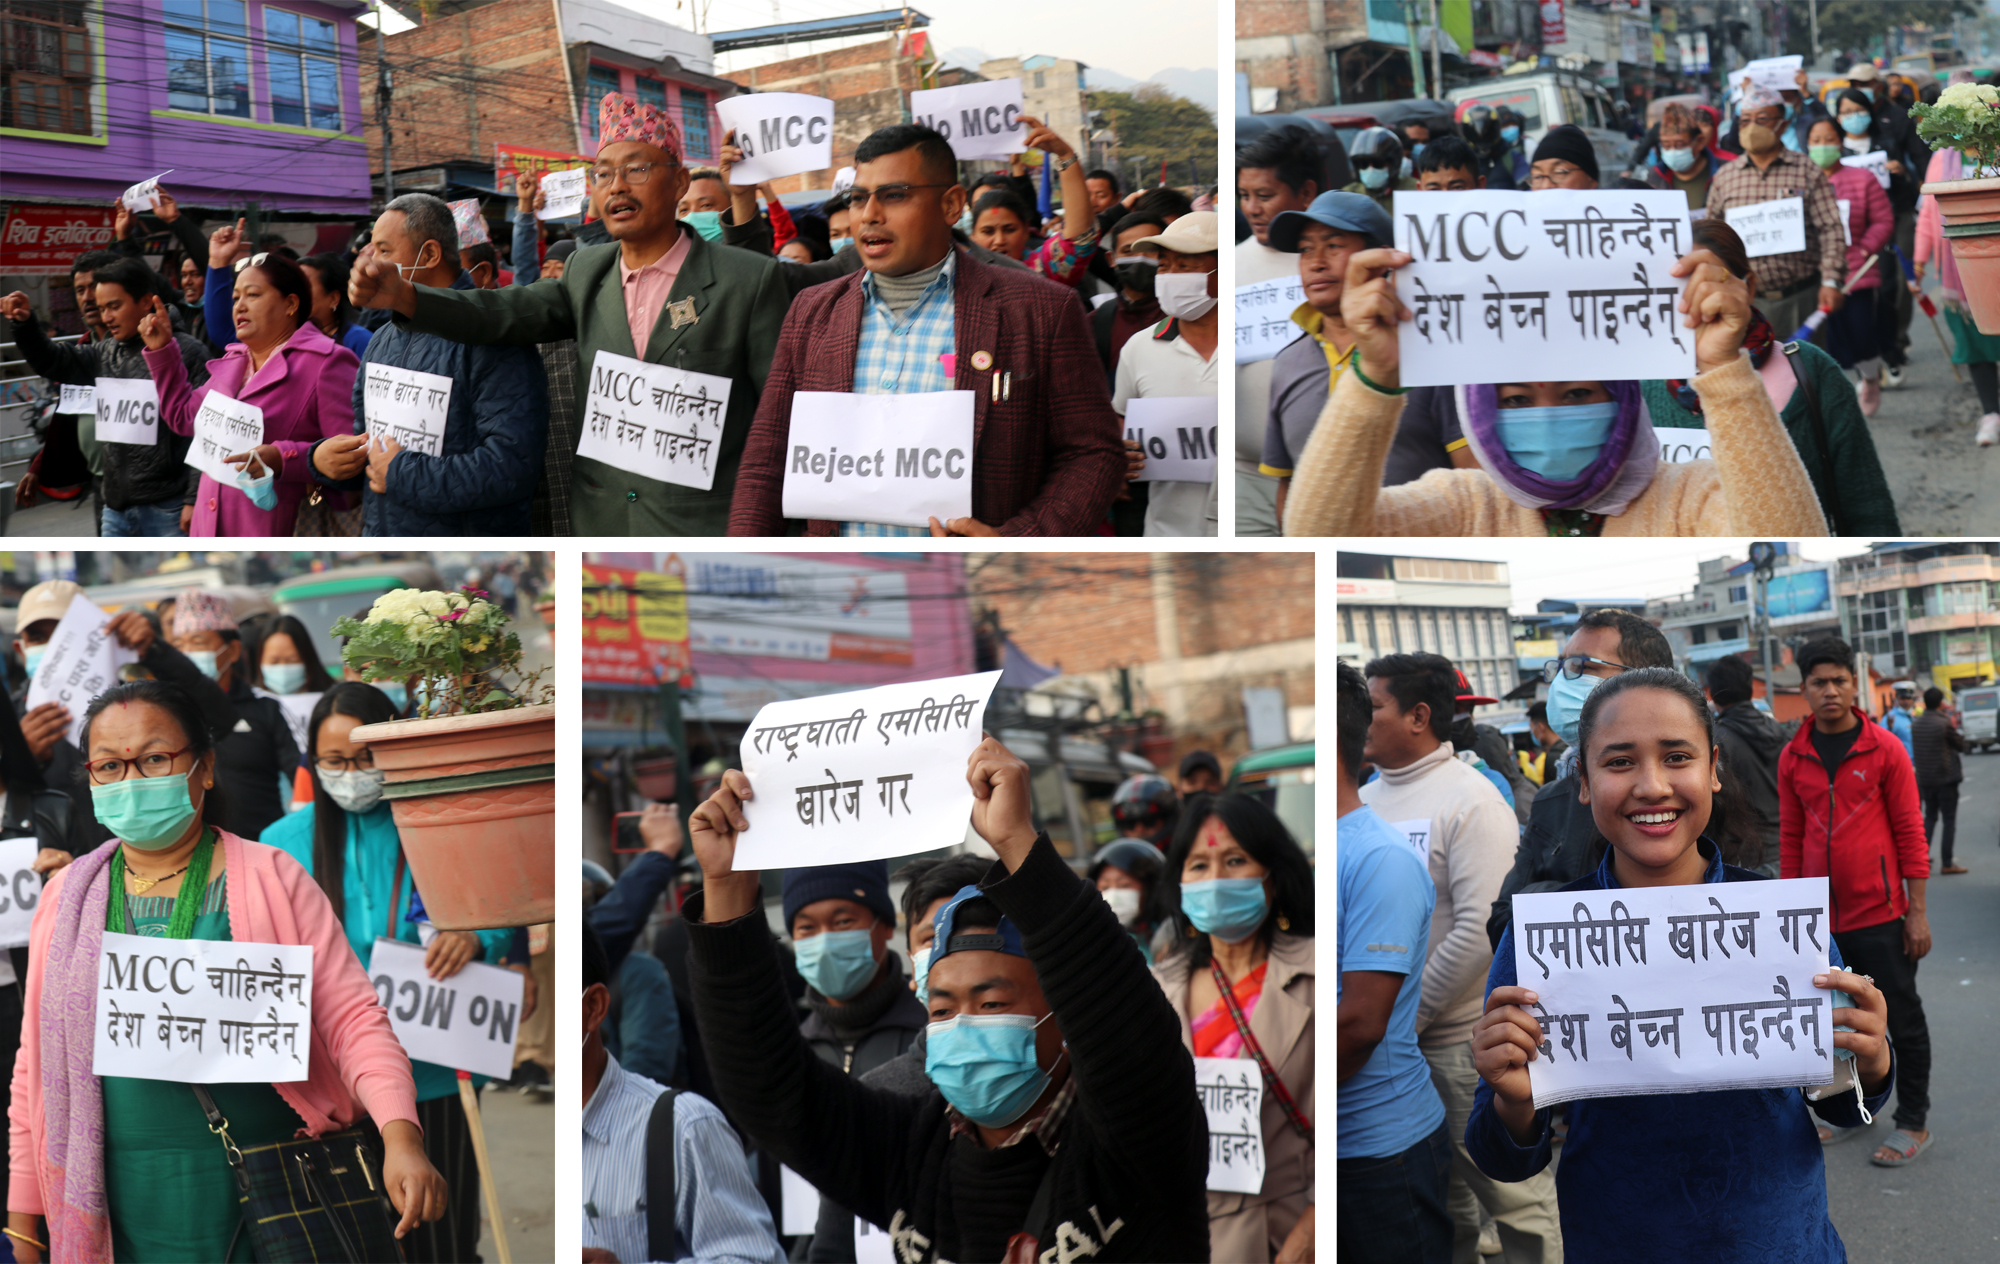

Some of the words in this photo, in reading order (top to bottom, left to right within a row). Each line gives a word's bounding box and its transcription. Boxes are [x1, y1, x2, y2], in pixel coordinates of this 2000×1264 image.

[760, 115, 827, 154] MCC
[961, 103, 1021, 138] MCC
[6, 218, 42, 245] शिव
[1403, 209, 1529, 264] MCC
[1543, 202, 1685, 260] चाहिन्दैन्
[1285, 285, 1304, 302] खा
[1413, 275, 1466, 345] देश
[1481, 274, 1550, 344] बेच्न
[1567, 262, 1688, 355] पाइन्दैन्
[1260, 315, 1290, 342] बेच्न
[97, 398, 110, 423] No
[114, 399, 156, 426] MCC
[427, 388, 447, 413] गर
[592, 365, 646, 406] MCC
[651, 383, 723, 430] चाहिन्दैन्
[590, 401, 611, 442] देश
[616, 409, 647, 451] बेच्न
[654, 422, 713, 478] पाइन्दैन्
[791, 445, 885, 483] Reject
[895, 447, 966, 480] MCC
[1127, 427, 1167, 460] No
[753, 708, 868, 762] राष्ट्रघाती
[877, 694, 980, 746] एमसिसि
[795, 768, 864, 829] खारेज
[877, 773, 914, 818] गर
[1524, 900, 1650, 980] एमसिसि
[1667, 896, 1760, 964] खारेज
[1777, 907, 1824, 954] गर
[103, 951, 195, 995] MCC
[206, 957, 307, 1008] चाहिन्दैन्
[373, 974, 457, 1031] MCC
[107, 998, 145, 1049] देश
[157, 1001, 207, 1055] बेच्न
[219, 1006, 302, 1065] पाइन्दैन्
[469, 995, 517, 1044] No
[1532, 1001, 1590, 1064] देश
[1607, 994, 1684, 1061] बेच्न
[1702, 975, 1828, 1061] पाइन्दैन्
[1039, 1204, 1126, 1264] AL
